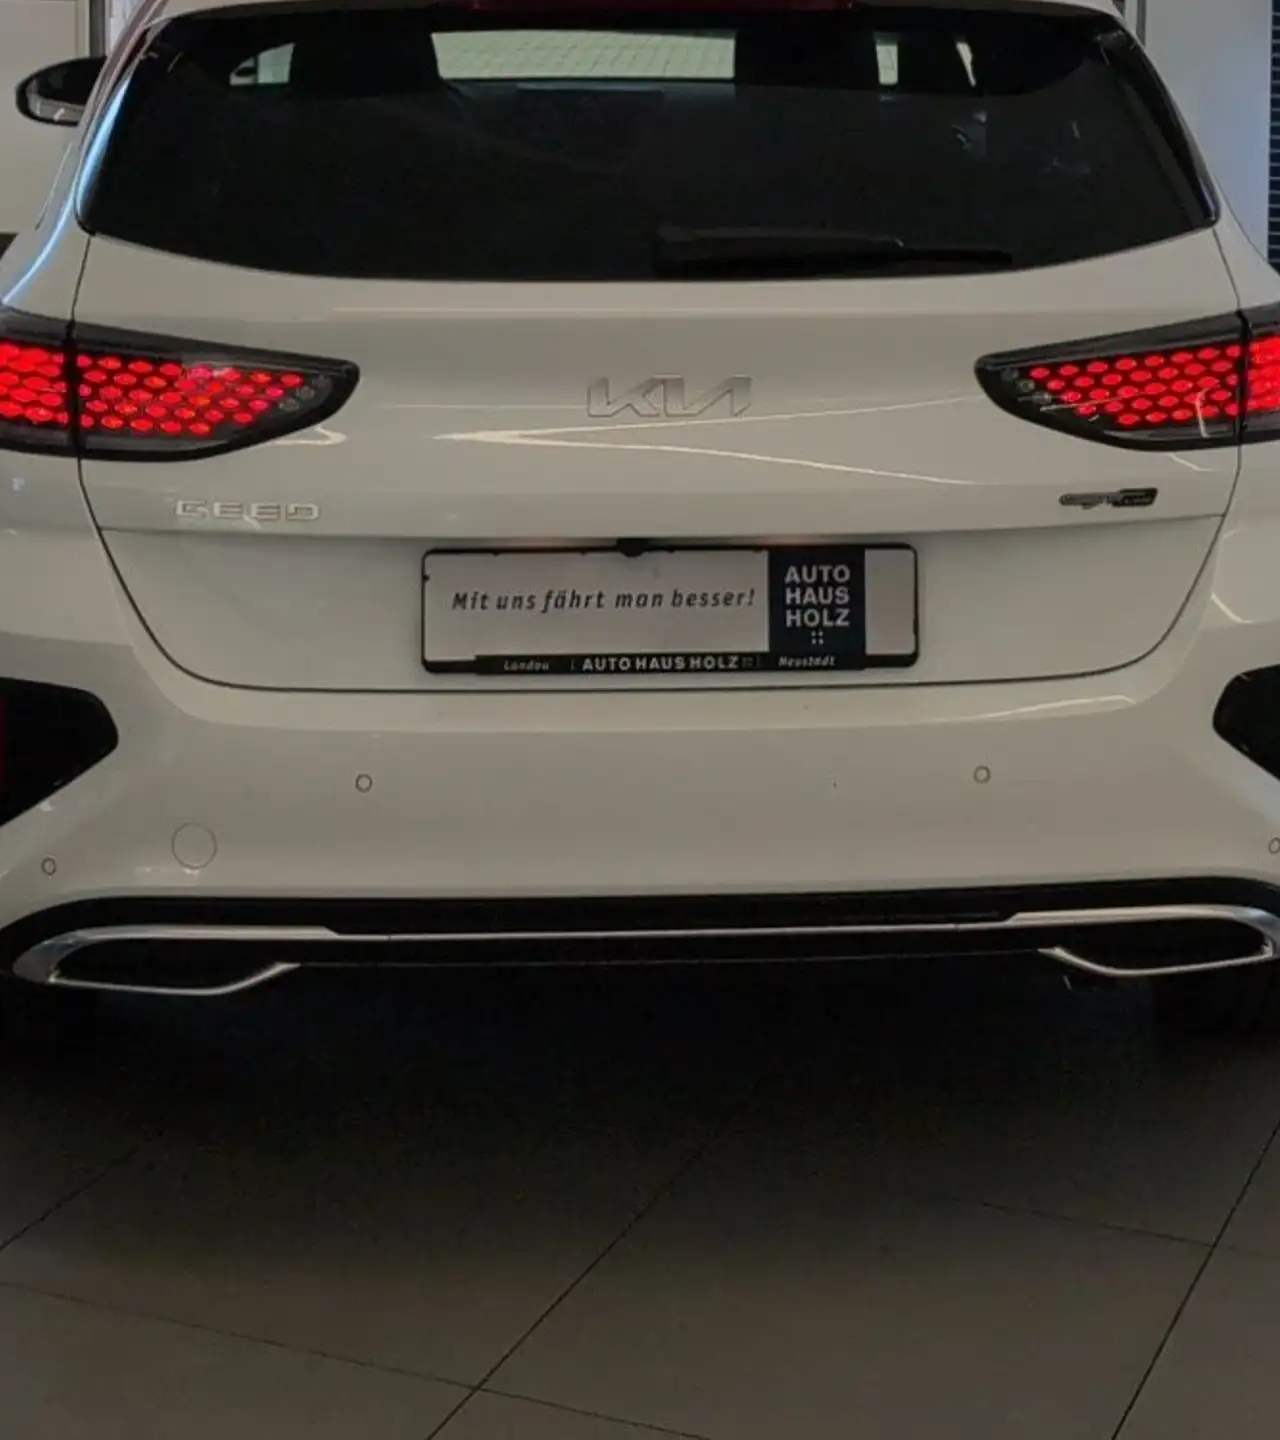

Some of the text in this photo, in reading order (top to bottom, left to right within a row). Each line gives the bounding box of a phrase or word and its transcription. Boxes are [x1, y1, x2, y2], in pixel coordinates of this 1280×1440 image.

[784, 564, 851, 584] AUTO
[451, 587, 756, 614] Mit uns fährt man besser!
[784, 586, 851, 606] HAUS
[785, 607, 851, 628] HOLZ
[689, 654, 741, 671] HOLZ
